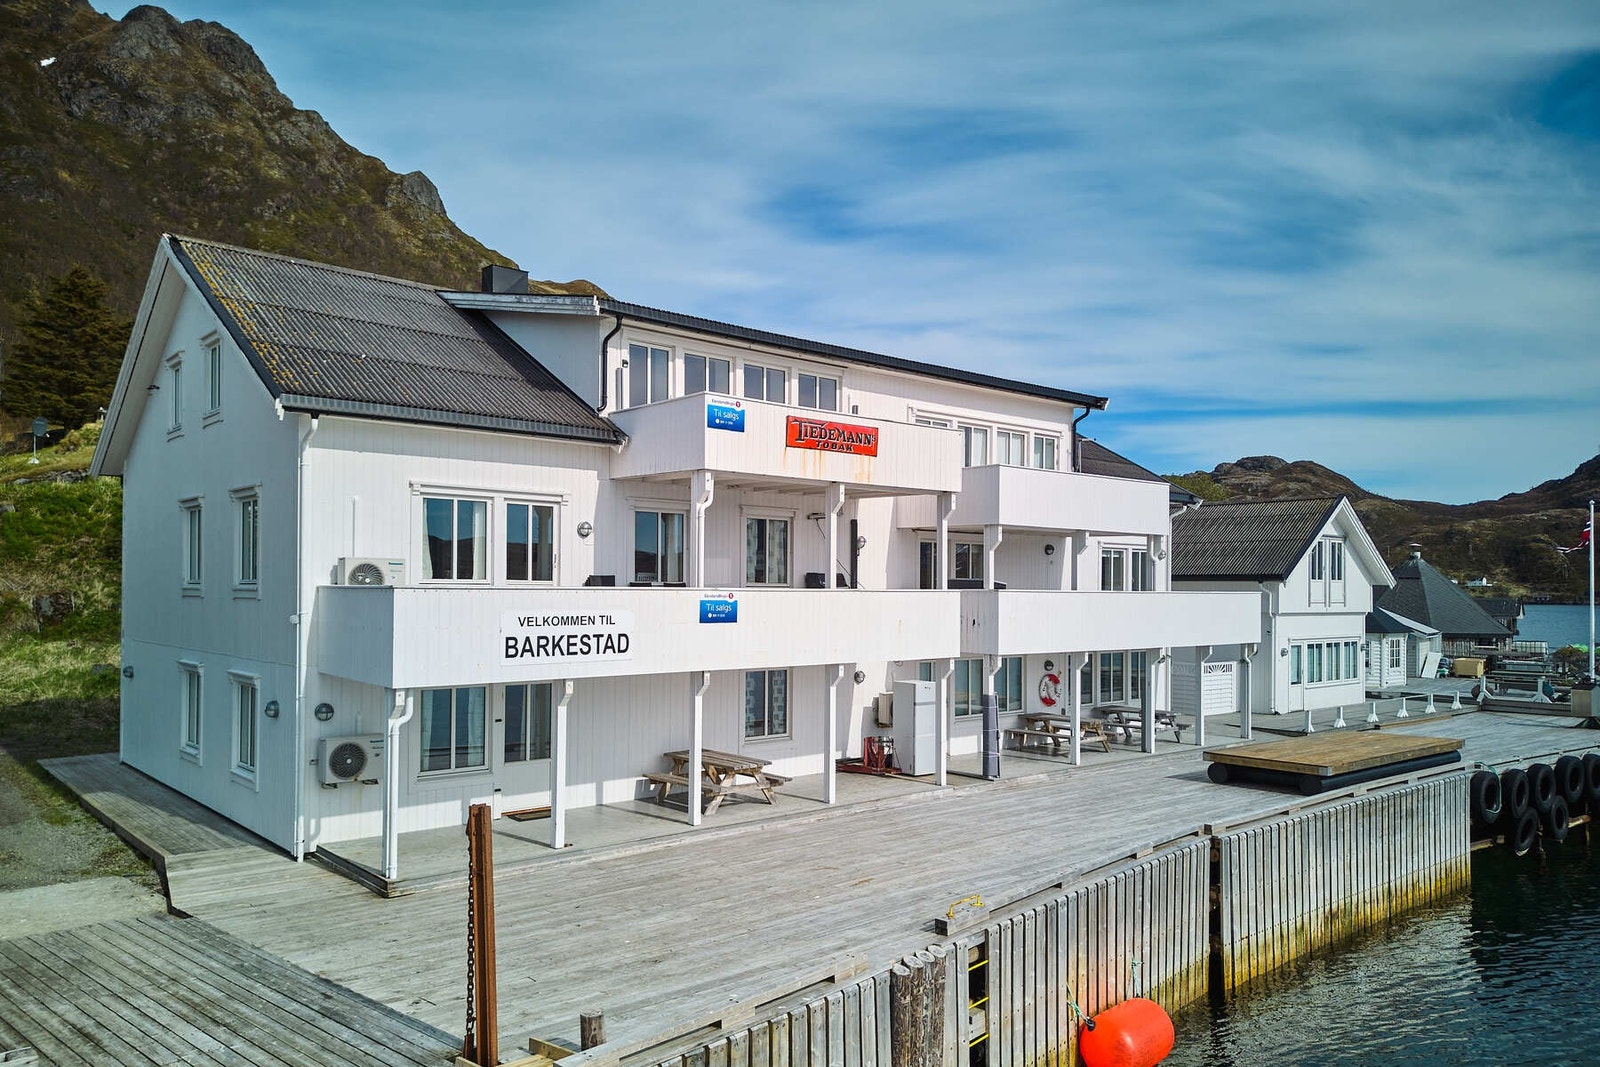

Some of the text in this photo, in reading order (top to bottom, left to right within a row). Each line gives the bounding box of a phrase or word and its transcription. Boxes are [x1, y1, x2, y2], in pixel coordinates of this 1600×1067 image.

[713, 408, 740, 421] Til salgs
[816, 440, 853, 452] TOBAK
[706, 603, 732, 613] Til salgs
[518, 615, 615, 627] VELKOMMEN TIL
[505, 633, 630, 658] BARKESTAD
